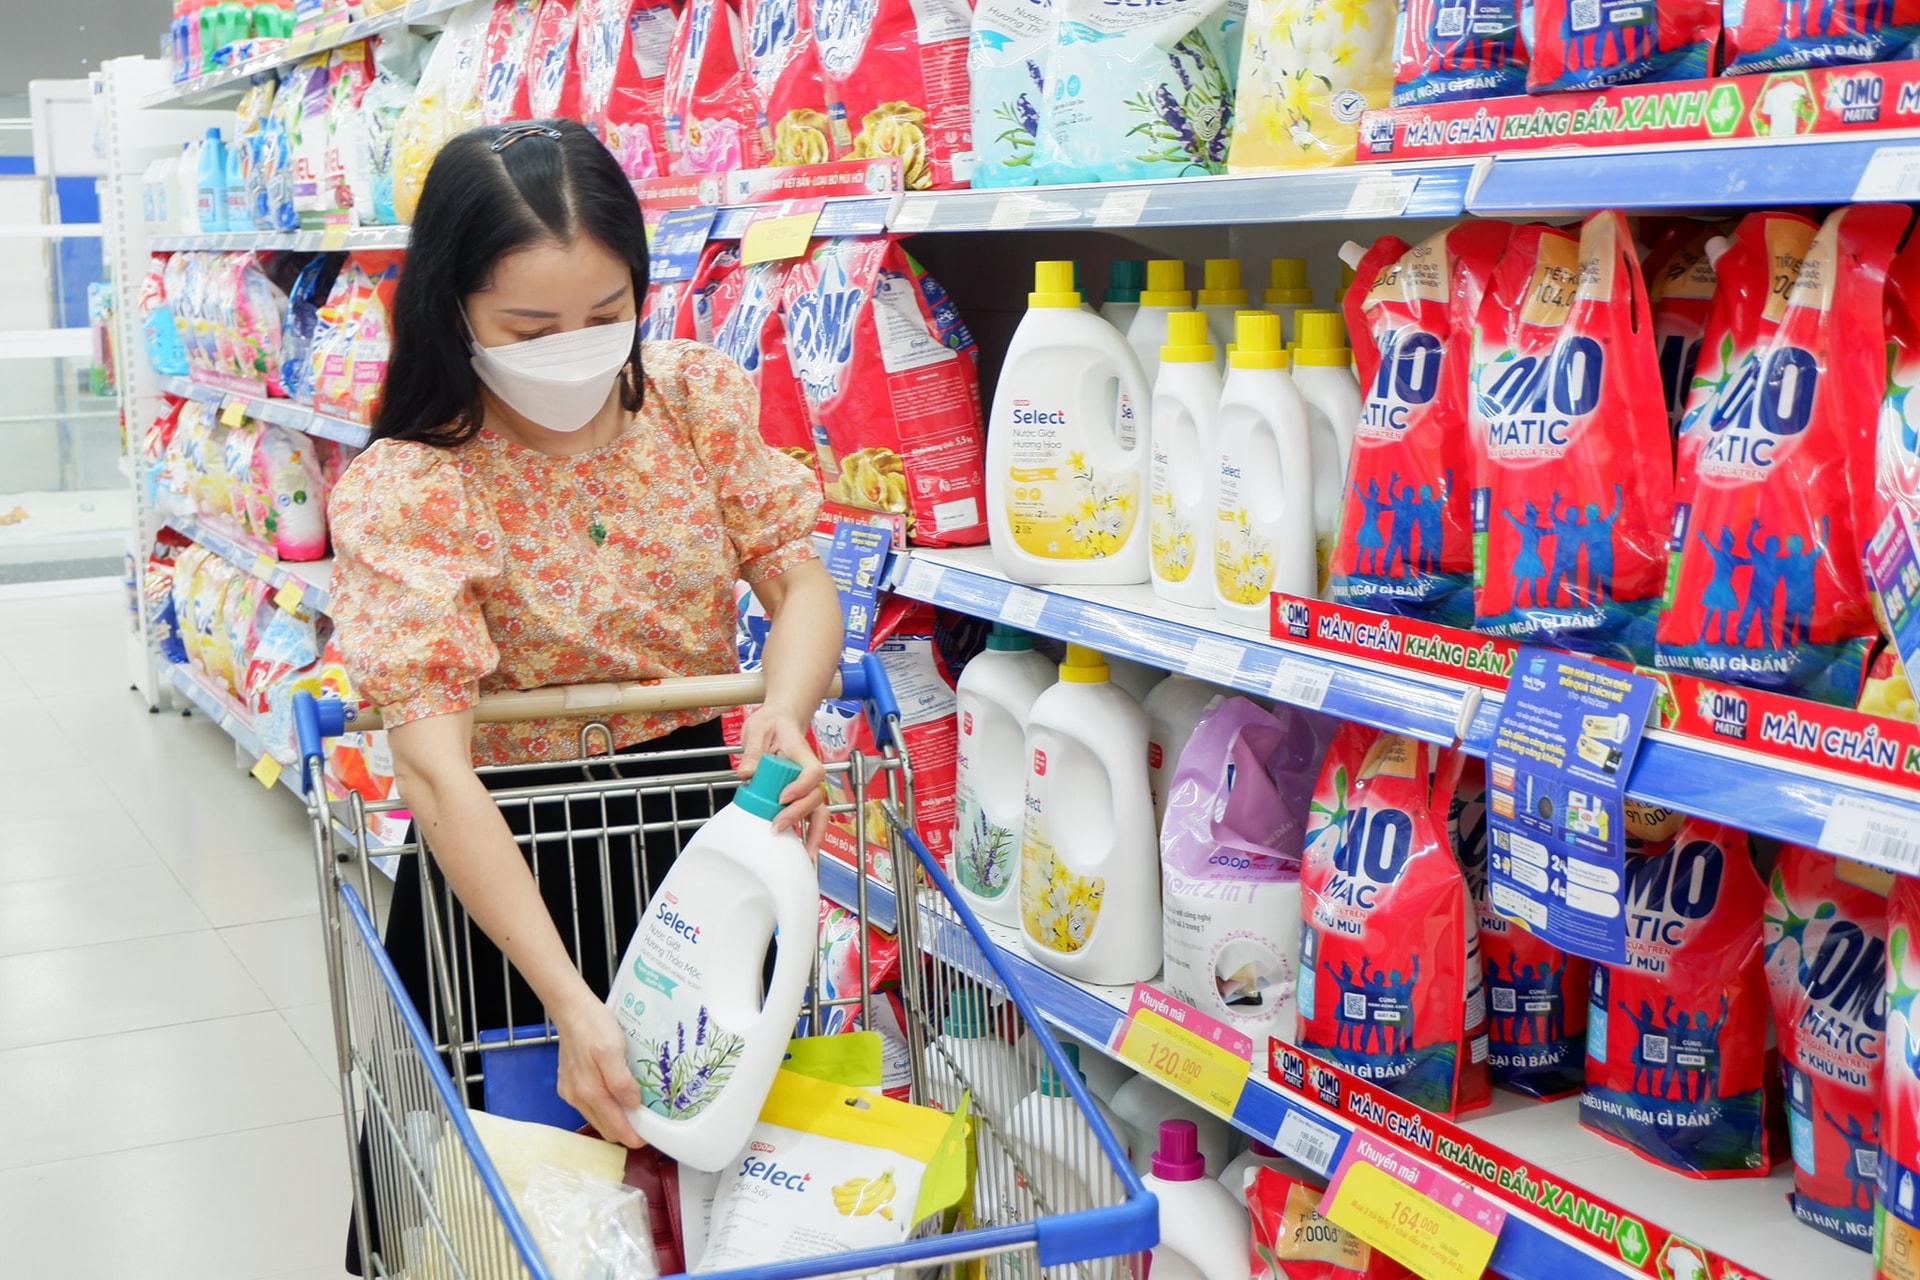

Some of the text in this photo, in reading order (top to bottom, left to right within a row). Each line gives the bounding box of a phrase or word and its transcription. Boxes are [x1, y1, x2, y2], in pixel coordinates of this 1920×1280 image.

[1843, 76, 1884, 107] OMO
[1404, 90, 1708, 147] MÀN CHẮN KHÁNG BẨN XANH
[1843, 107, 1879, 122] MATIC
[1012, 408, 1067, 426] Select
[1488, 419, 1570, 447] MATIC
[1287, 603, 1310, 627] OMO
[1318, 612, 1505, 677] MÀN CHẮN KHÁNG BẨN
[1712, 693, 1748, 723] OMO
[1713, 721, 1746, 739] MATIC
[1761, 711, 1818, 750] MÀN
[1823, 725, 1897, 767] CHẮN
[824, 832, 839, 849] LOẠI
[849, 843, 859, 857] MÙ
[1492, 853, 1501, 869] 3
[1551, 855, 1560, 872] 2
[1219, 879, 1242, 902] in
[1550, 877, 1560, 897] 4
[656, 902, 702, 945] Select
[1337, 917, 1362, 935] MÙI
[1481, 917, 1507, 933] MÙI
[1625, 913, 1686, 946] TIC
[1636, 955, 1666, 973] MÙI
[1138, 989, 1170, 1016] Khuyến
[1169, 1007, 1187, 1025] mãi
[1799, 1003, 1879, 1060] MATIC
[1282, 1053, 1305, 1079] OMO
[1357, 1060, 1373, 1079] GÌ
[1488, 1054, 1509, 1069] GẠI
[1512, 1053, 1526, 1068] GÌ
[1318, 1070, 1341, 1097] OMO
[1837, 1067, 1867, 1087] MÙI
[1602, 1100, 1626, 1119] HAY,
[1626, 1106, 1655, 1126] NGẠI
[1657, 1108, 1674, 1126] GÌ
[738, 1155, 811, 1194] Select
[1348, 1090, 1386, 1126] MÀN
[1386, 1112, 1434, 1149] CHẮN
[1437, 1132, 1497, 1183] KHÁNG
[1498, 1166, 1539, 1205] BẨN
[1538, 1179, 1617, 1242] XANH
[1356, 1139, 1421, 1185] Khuyến mãi
[1812, 1211, 1875, 1243] HAY, NGẠ
